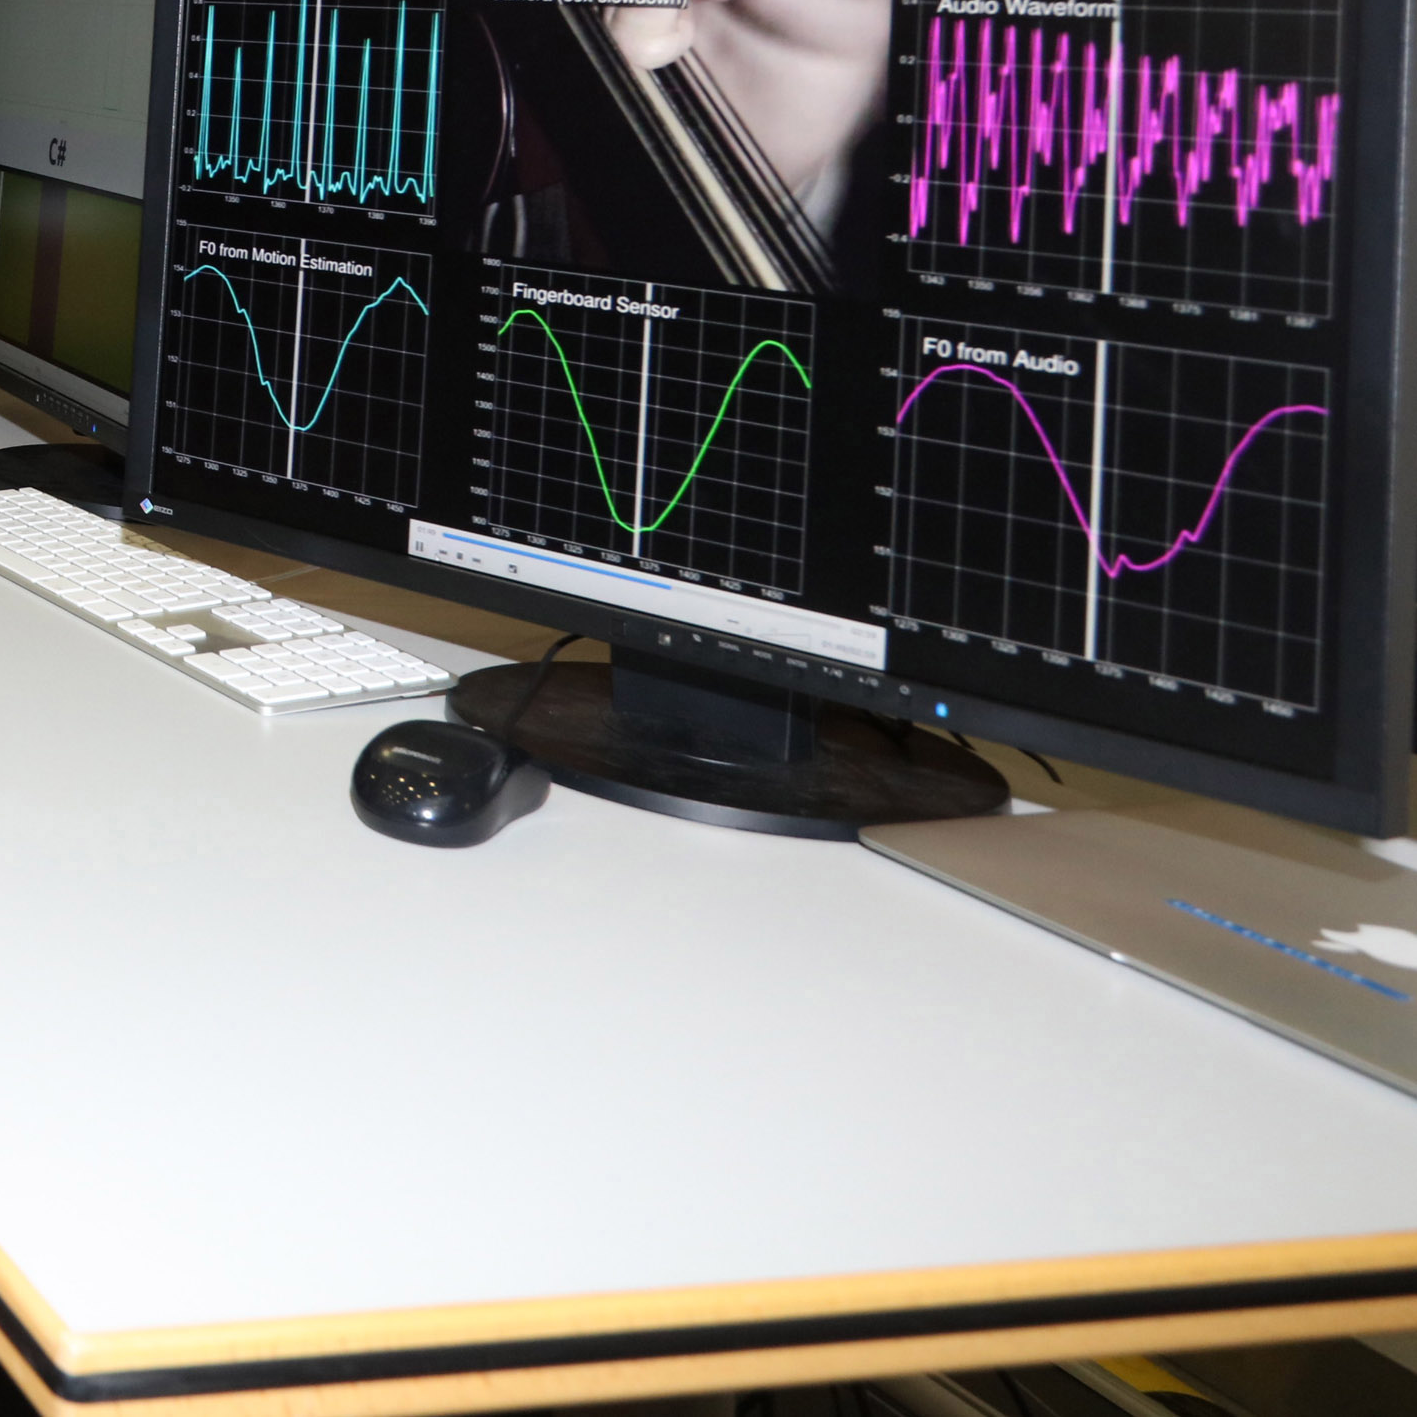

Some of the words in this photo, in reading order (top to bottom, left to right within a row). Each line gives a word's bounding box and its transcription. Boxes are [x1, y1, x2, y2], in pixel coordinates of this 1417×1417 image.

[49, 137, 66, 167] C#
[199, 240, 216, 255] F0
[219, 243, 248, 260] from
[252, 248, 296, 267] Motion
[300, 253, 372, 277] Estimation
[513, 282, 612, 311] Fingerboard
[616, 297, 679, 319] Sensor
[923, 336, 952, 358] F0
[957, 341, 1006, 366] from
[1013, 348, 1080, 376] Audio
